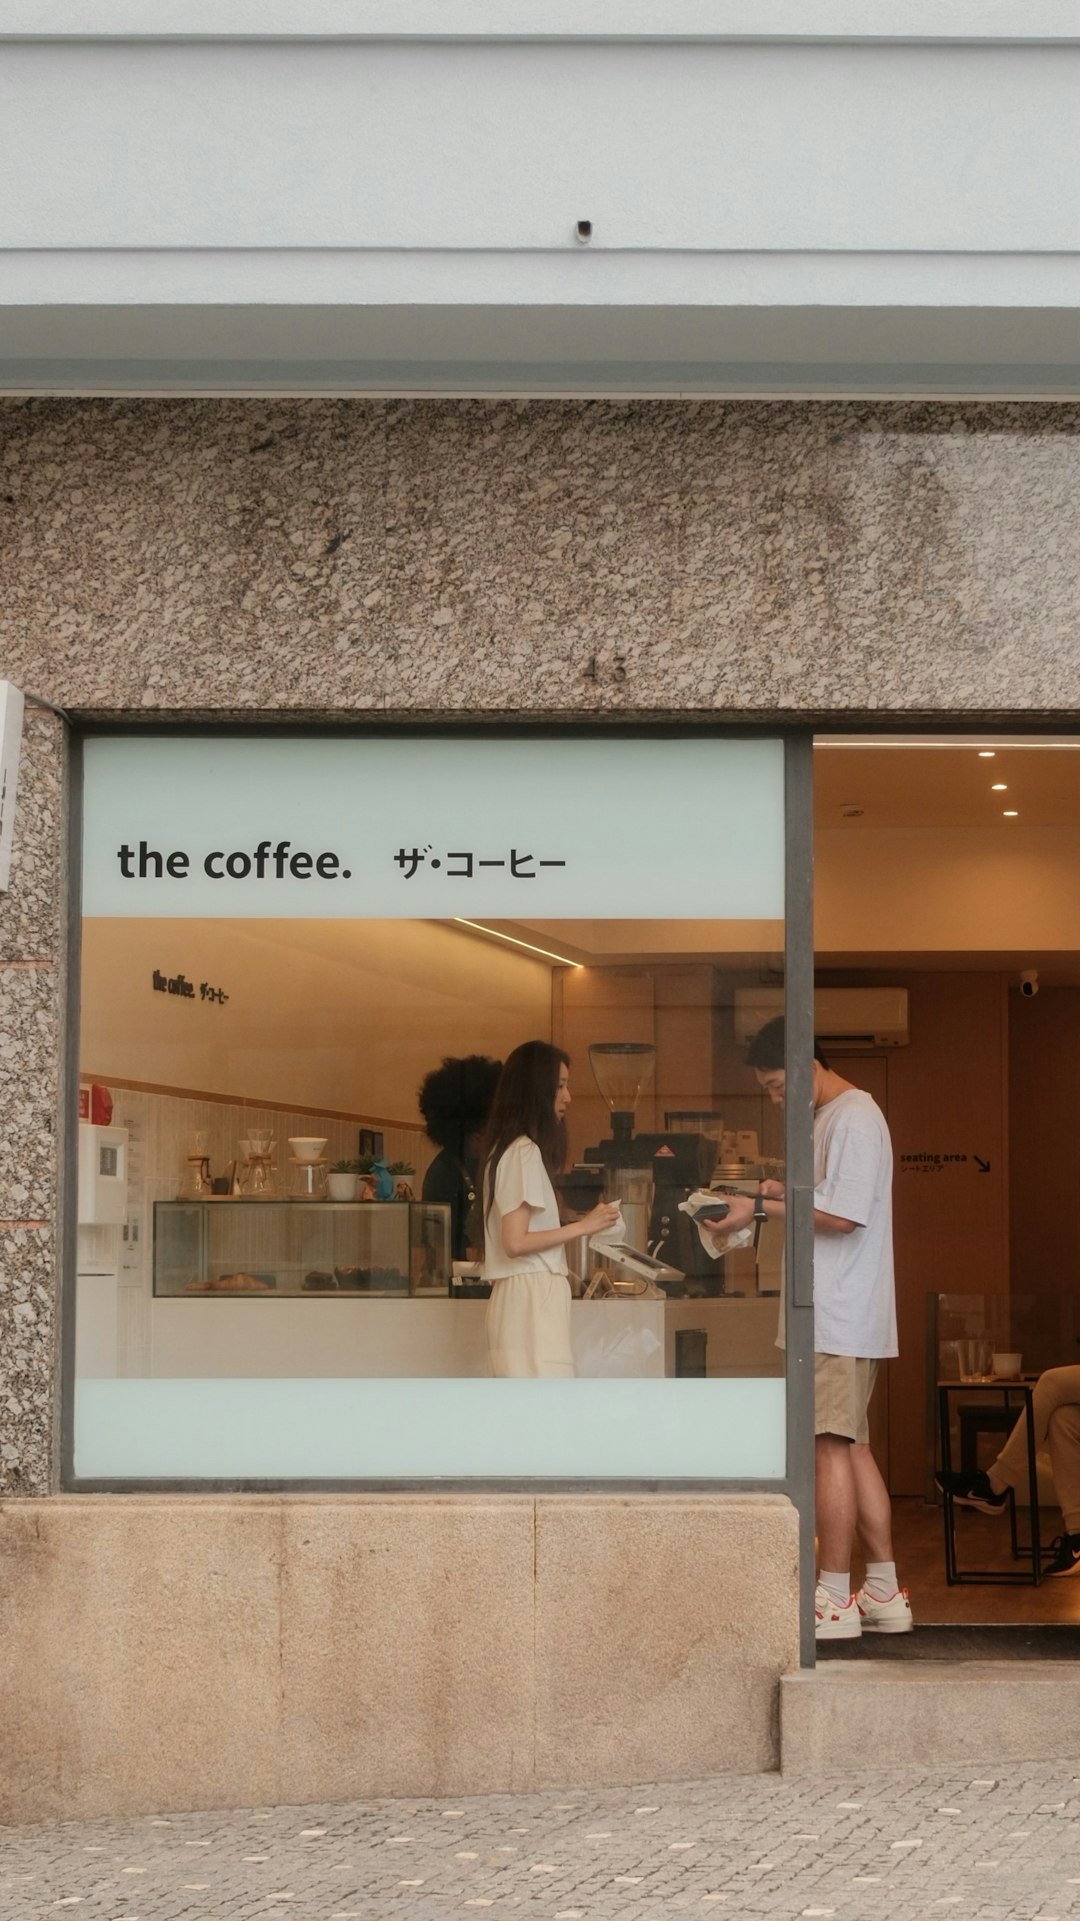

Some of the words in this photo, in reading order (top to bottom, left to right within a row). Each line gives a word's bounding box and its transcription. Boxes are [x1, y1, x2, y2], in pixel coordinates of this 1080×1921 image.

[117, 841, 189, 879] the
[203, 841, 352, 879] coffee.
[393, 844, 567, 880] ザ・コーヒー
[900, 1152, 941, 1164] seating
[943, 1153, 967, 1162] area
